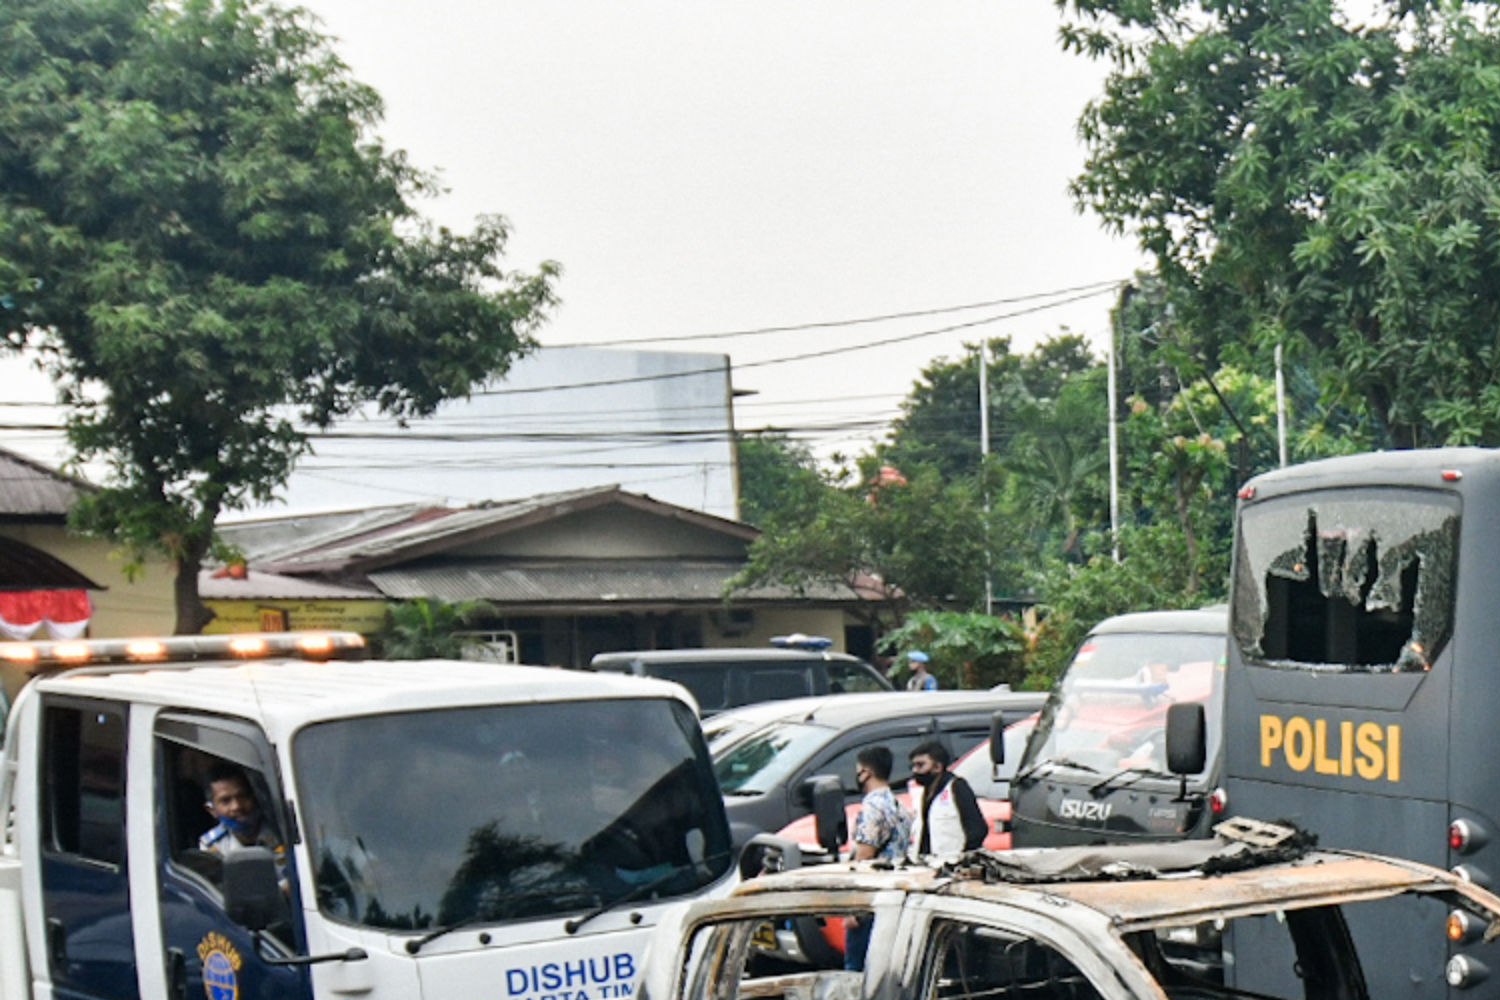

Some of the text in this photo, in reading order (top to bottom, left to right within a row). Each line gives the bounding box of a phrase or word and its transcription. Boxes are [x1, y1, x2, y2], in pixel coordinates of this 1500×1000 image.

[1259, 714, 1401, 782] POLISI
[1061, 799, 1112, 820] ISUZU
[197, 931, 241, 971] DISHUB
[506, 953, 635, 996] DISHUB
